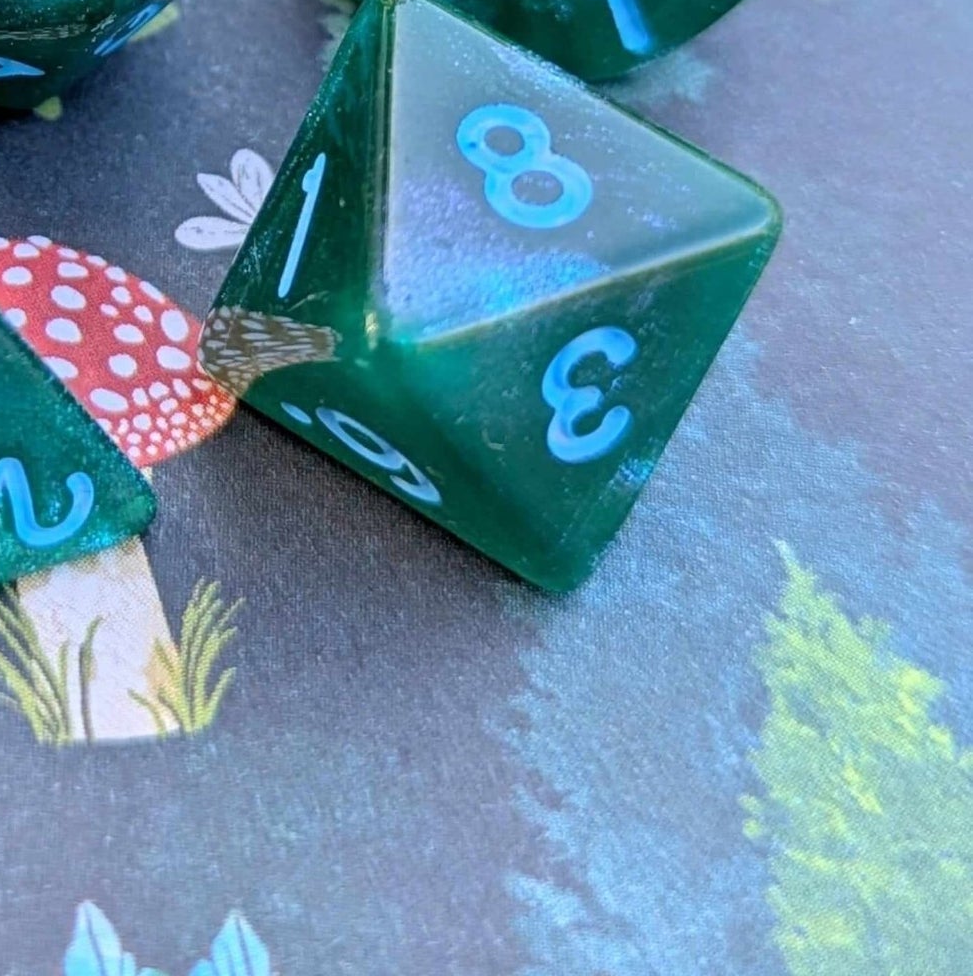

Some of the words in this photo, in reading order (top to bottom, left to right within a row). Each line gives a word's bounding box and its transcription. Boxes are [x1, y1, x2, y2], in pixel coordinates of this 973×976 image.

[276, 153, 326, 298] 1
[455, 103, 594, 228] 8
[541, 326, 637, 464] 3
